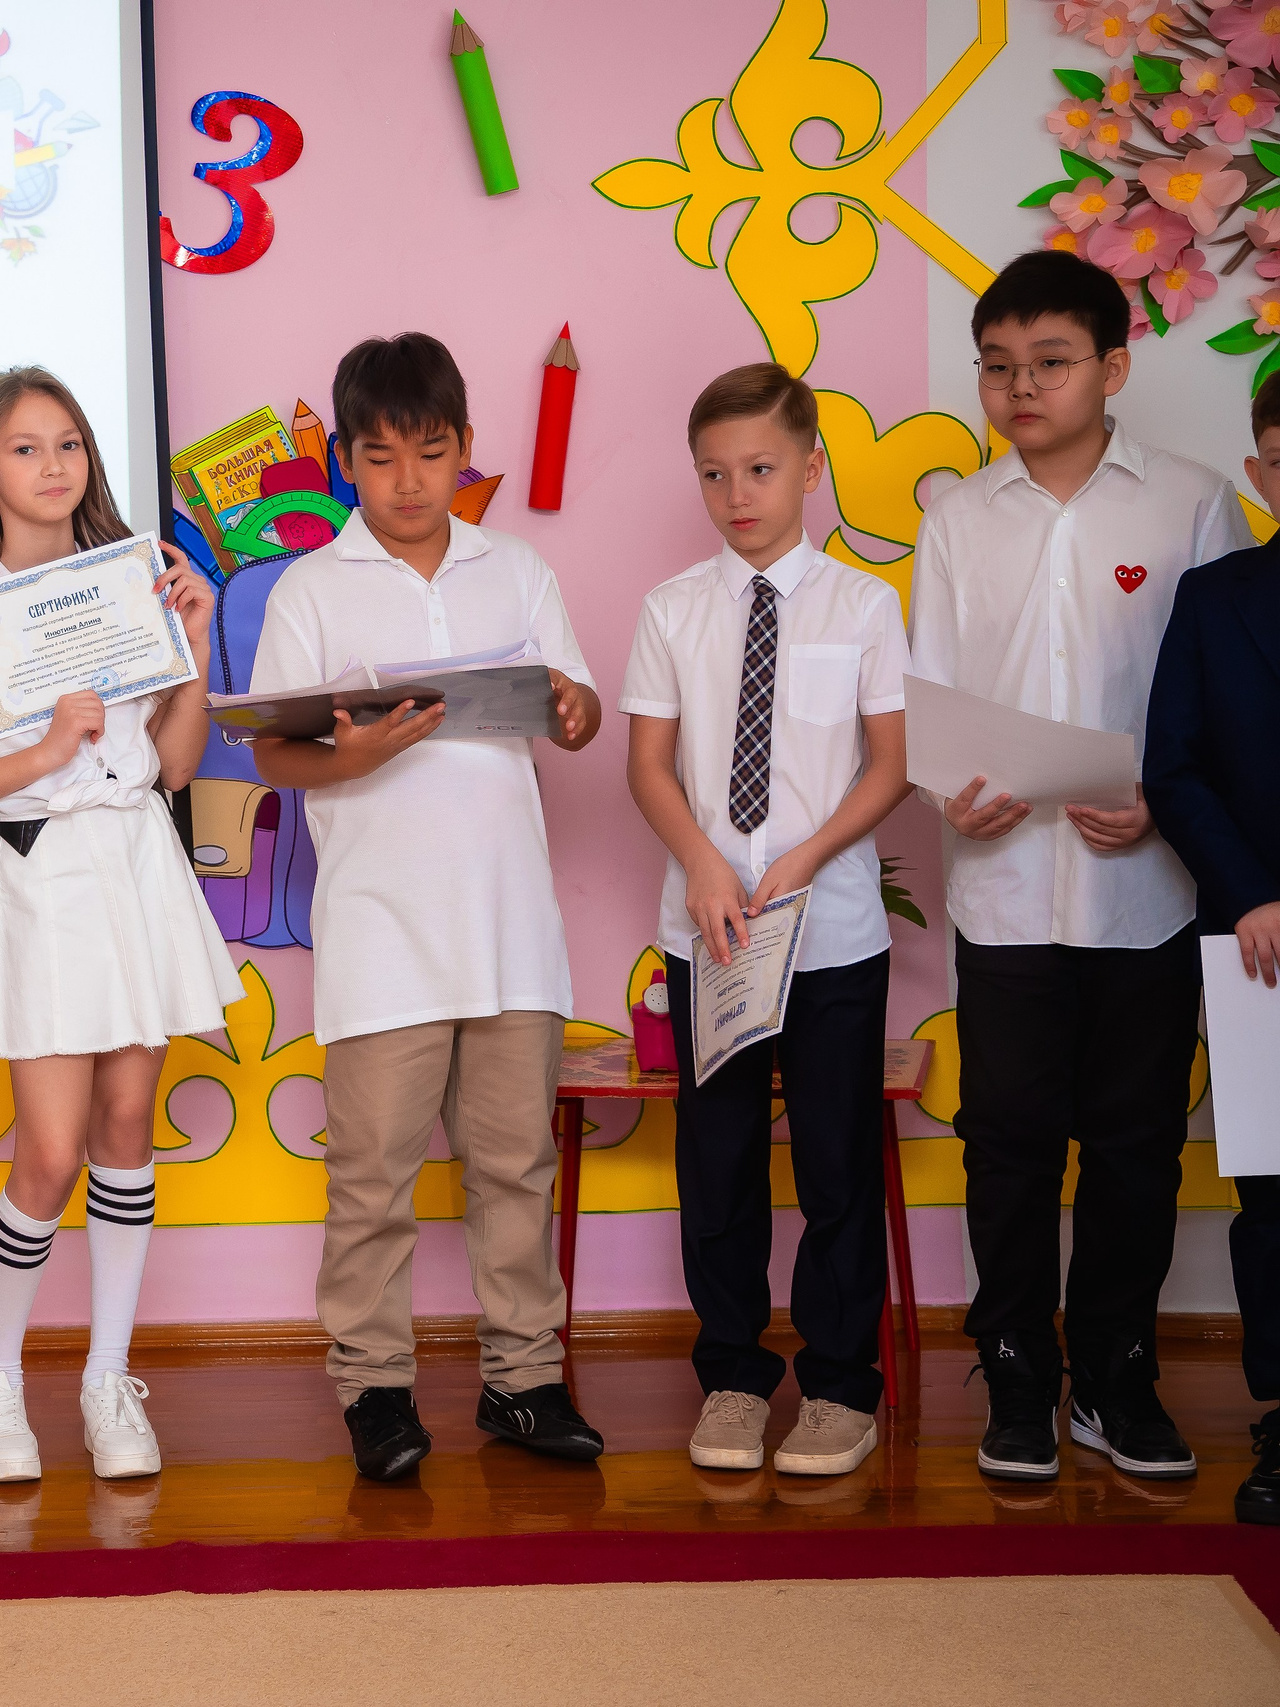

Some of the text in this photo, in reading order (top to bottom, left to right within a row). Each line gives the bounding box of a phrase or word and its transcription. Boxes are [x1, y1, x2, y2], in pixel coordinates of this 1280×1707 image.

[207, 439, 274, 480] БОЛЬШАЯ
[224, 459, 268, 488] КНИГА
[28, 585, 100, 619] СЕРТИФИКАТ
[43, 615, 102, 639] Инютина Алина
